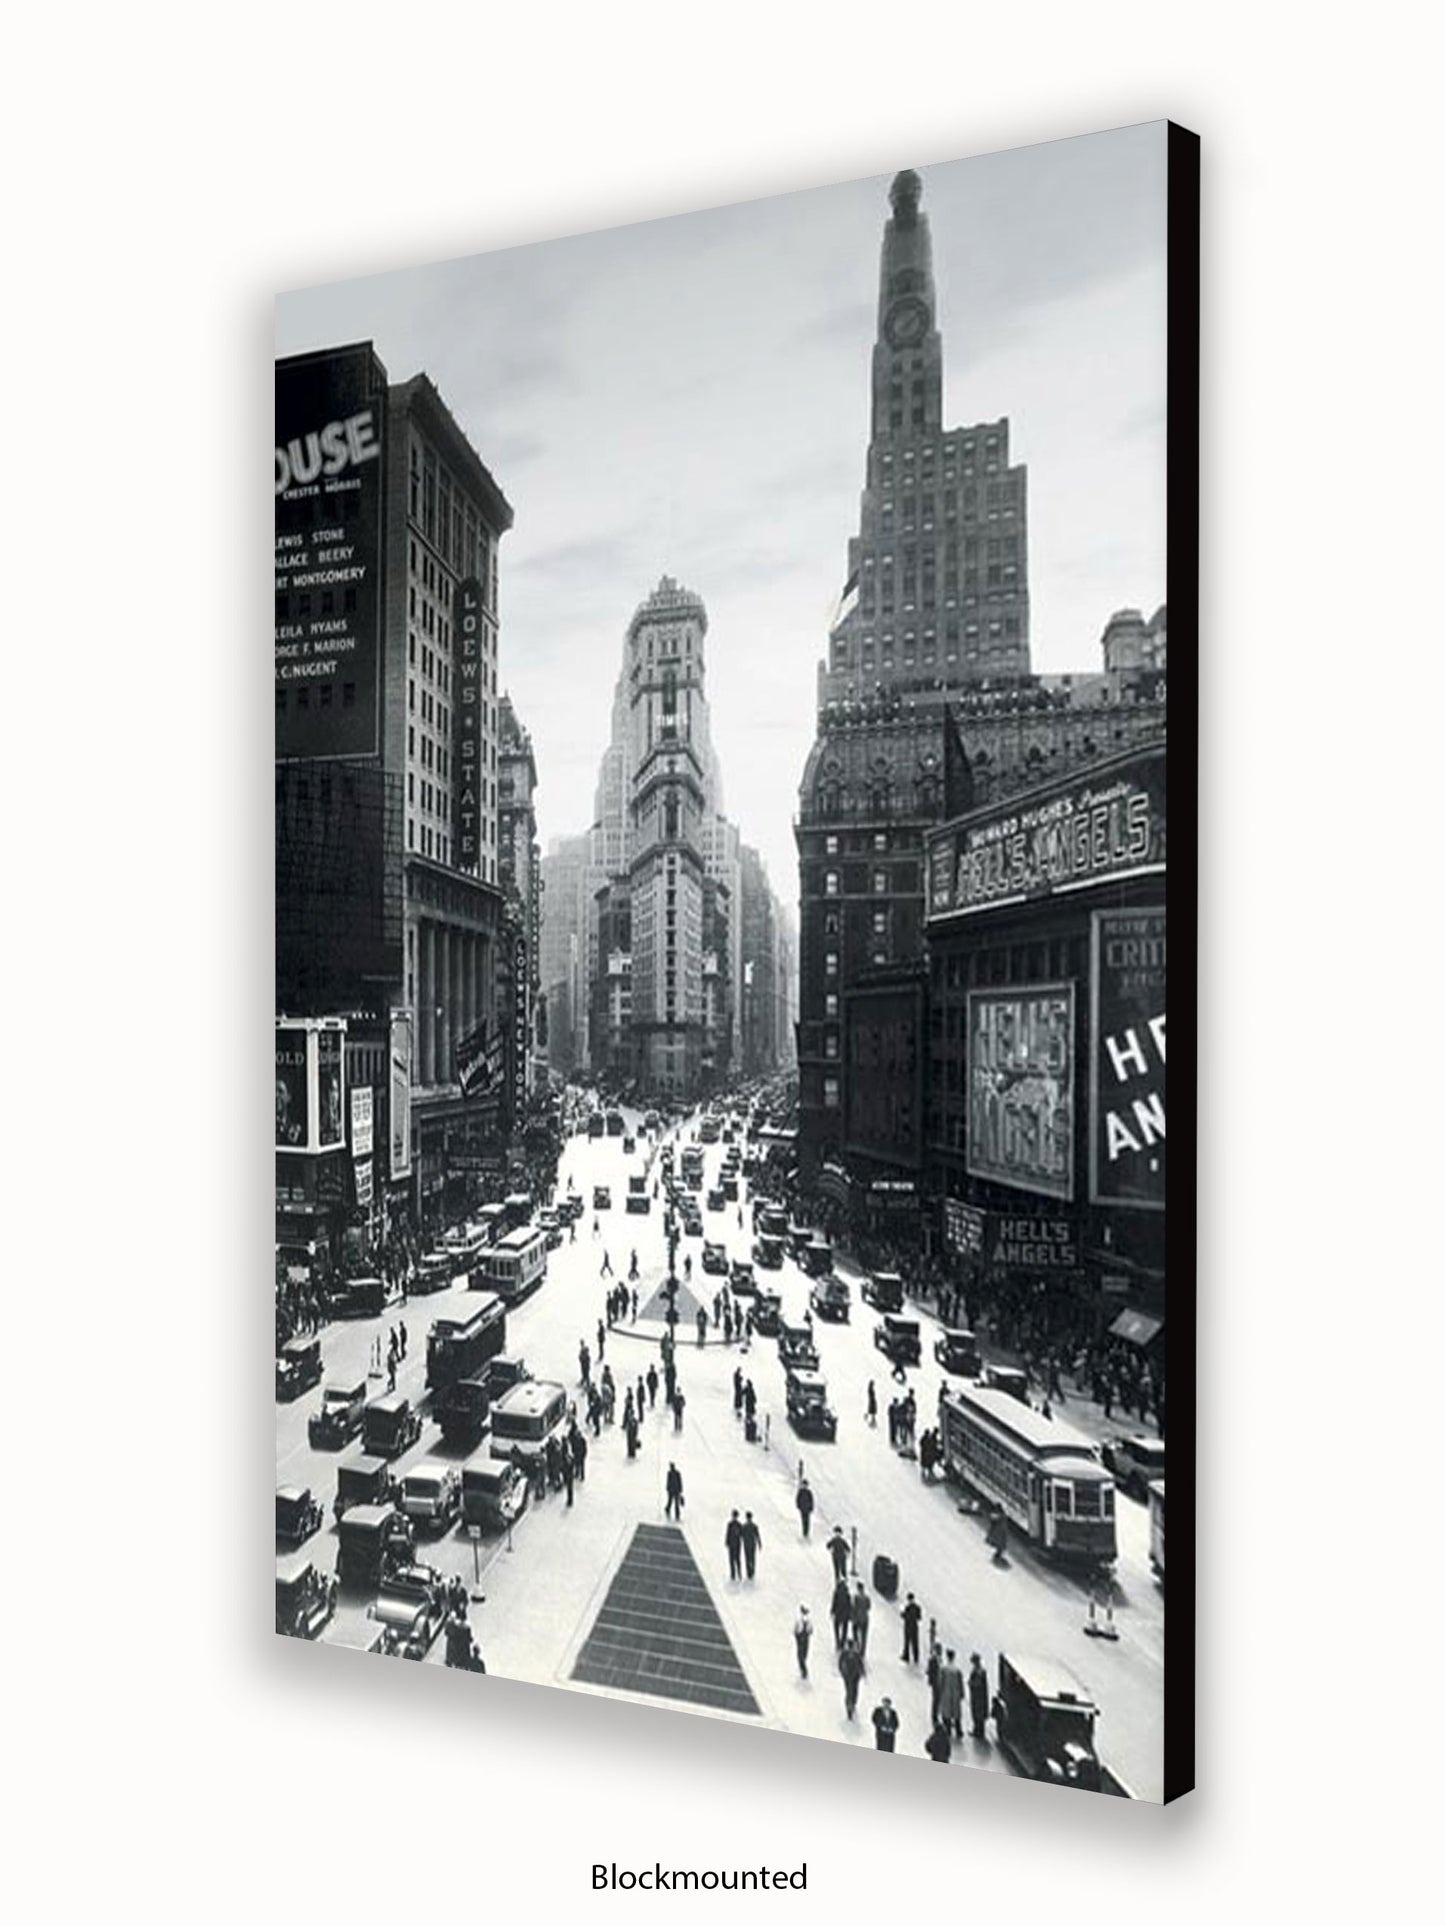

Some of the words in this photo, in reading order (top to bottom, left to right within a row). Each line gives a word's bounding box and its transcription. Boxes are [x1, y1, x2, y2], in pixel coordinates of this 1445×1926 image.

[312, 528, 344, 544] STONE
[318, 545, 354, 563] BEERY
[293, 565, 366, 587] MONTGOMERY
[314, 636, 355, 653] MARION
[1000, 1219, 1069, 1243] HELL'S
[992, 1242, 1076, 1267] ANGELS
